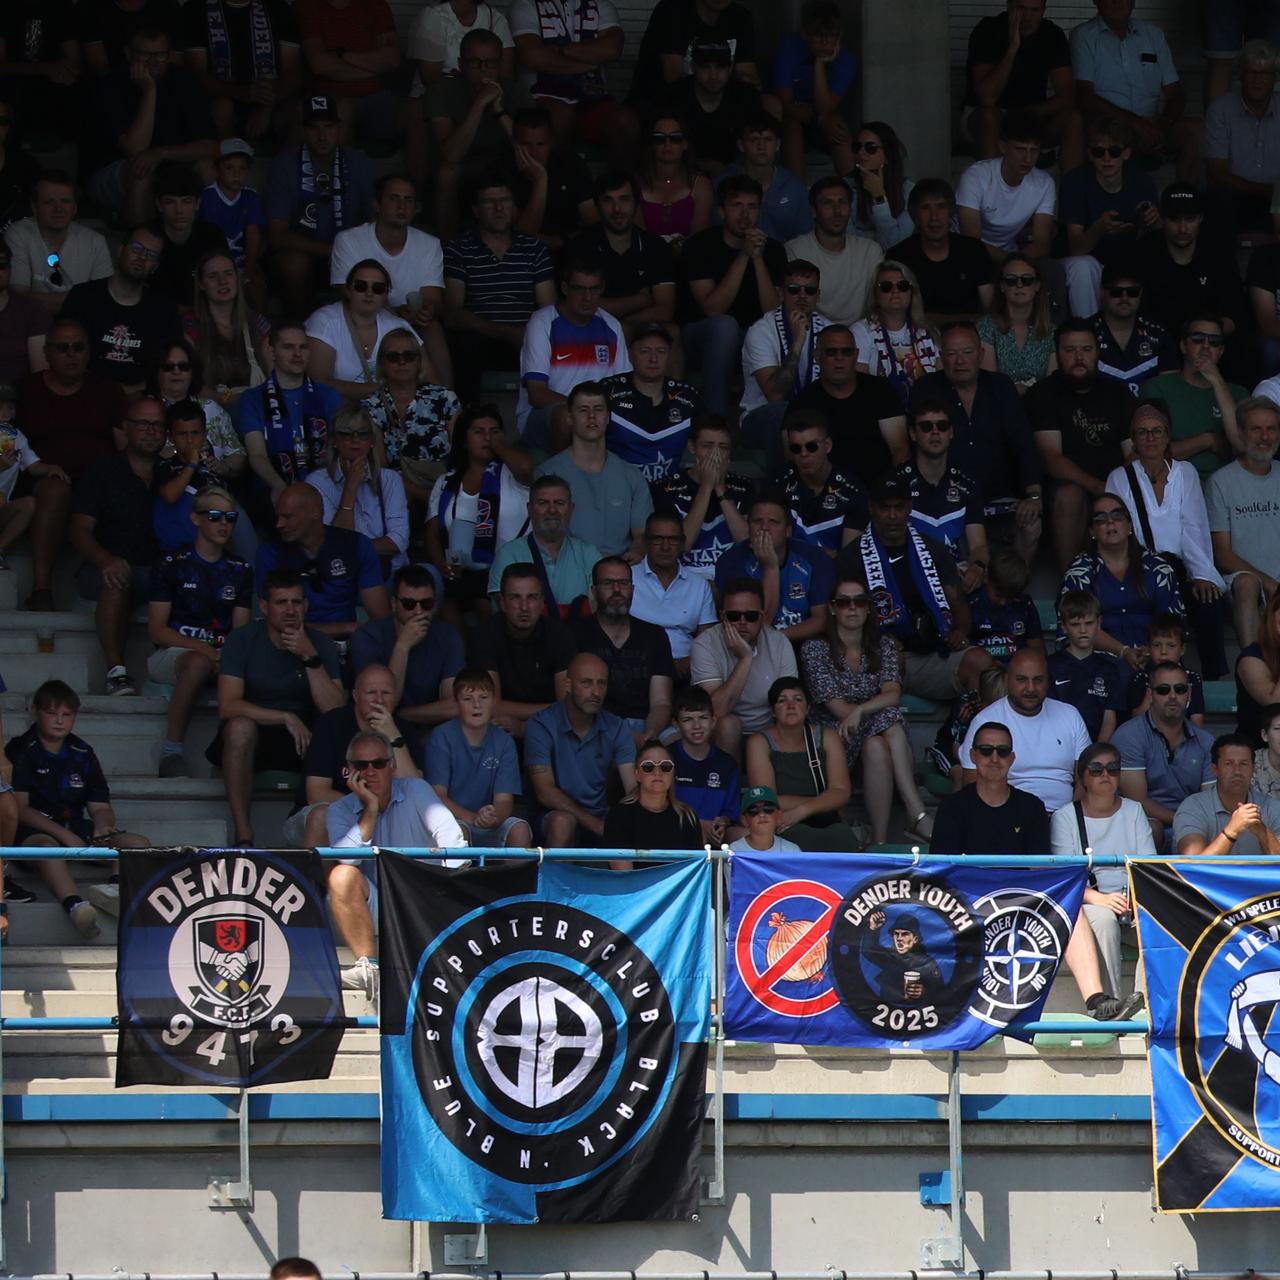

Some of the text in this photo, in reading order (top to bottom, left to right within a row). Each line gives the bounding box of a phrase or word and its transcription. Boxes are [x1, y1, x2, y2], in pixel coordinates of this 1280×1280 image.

[1235, 501, 1271, 514] SoulCal
[148, 858, 306, 925] DENDER
[843, 880, 974, 932] DENDER YOUTH
[1223, 906, 1247, 928] WIJ
[985, 916, 1053, 951] ENDER YOUTH
[426, 916, 660, 1042] SUPPORTERSCLUB
[161, 1013, 302, 1066] 9473
[872, 1004, 939, 1031] 2025
[433, 1075, 495, 1154] BLUE
[577, 1057, 658, 1157] BLACK
